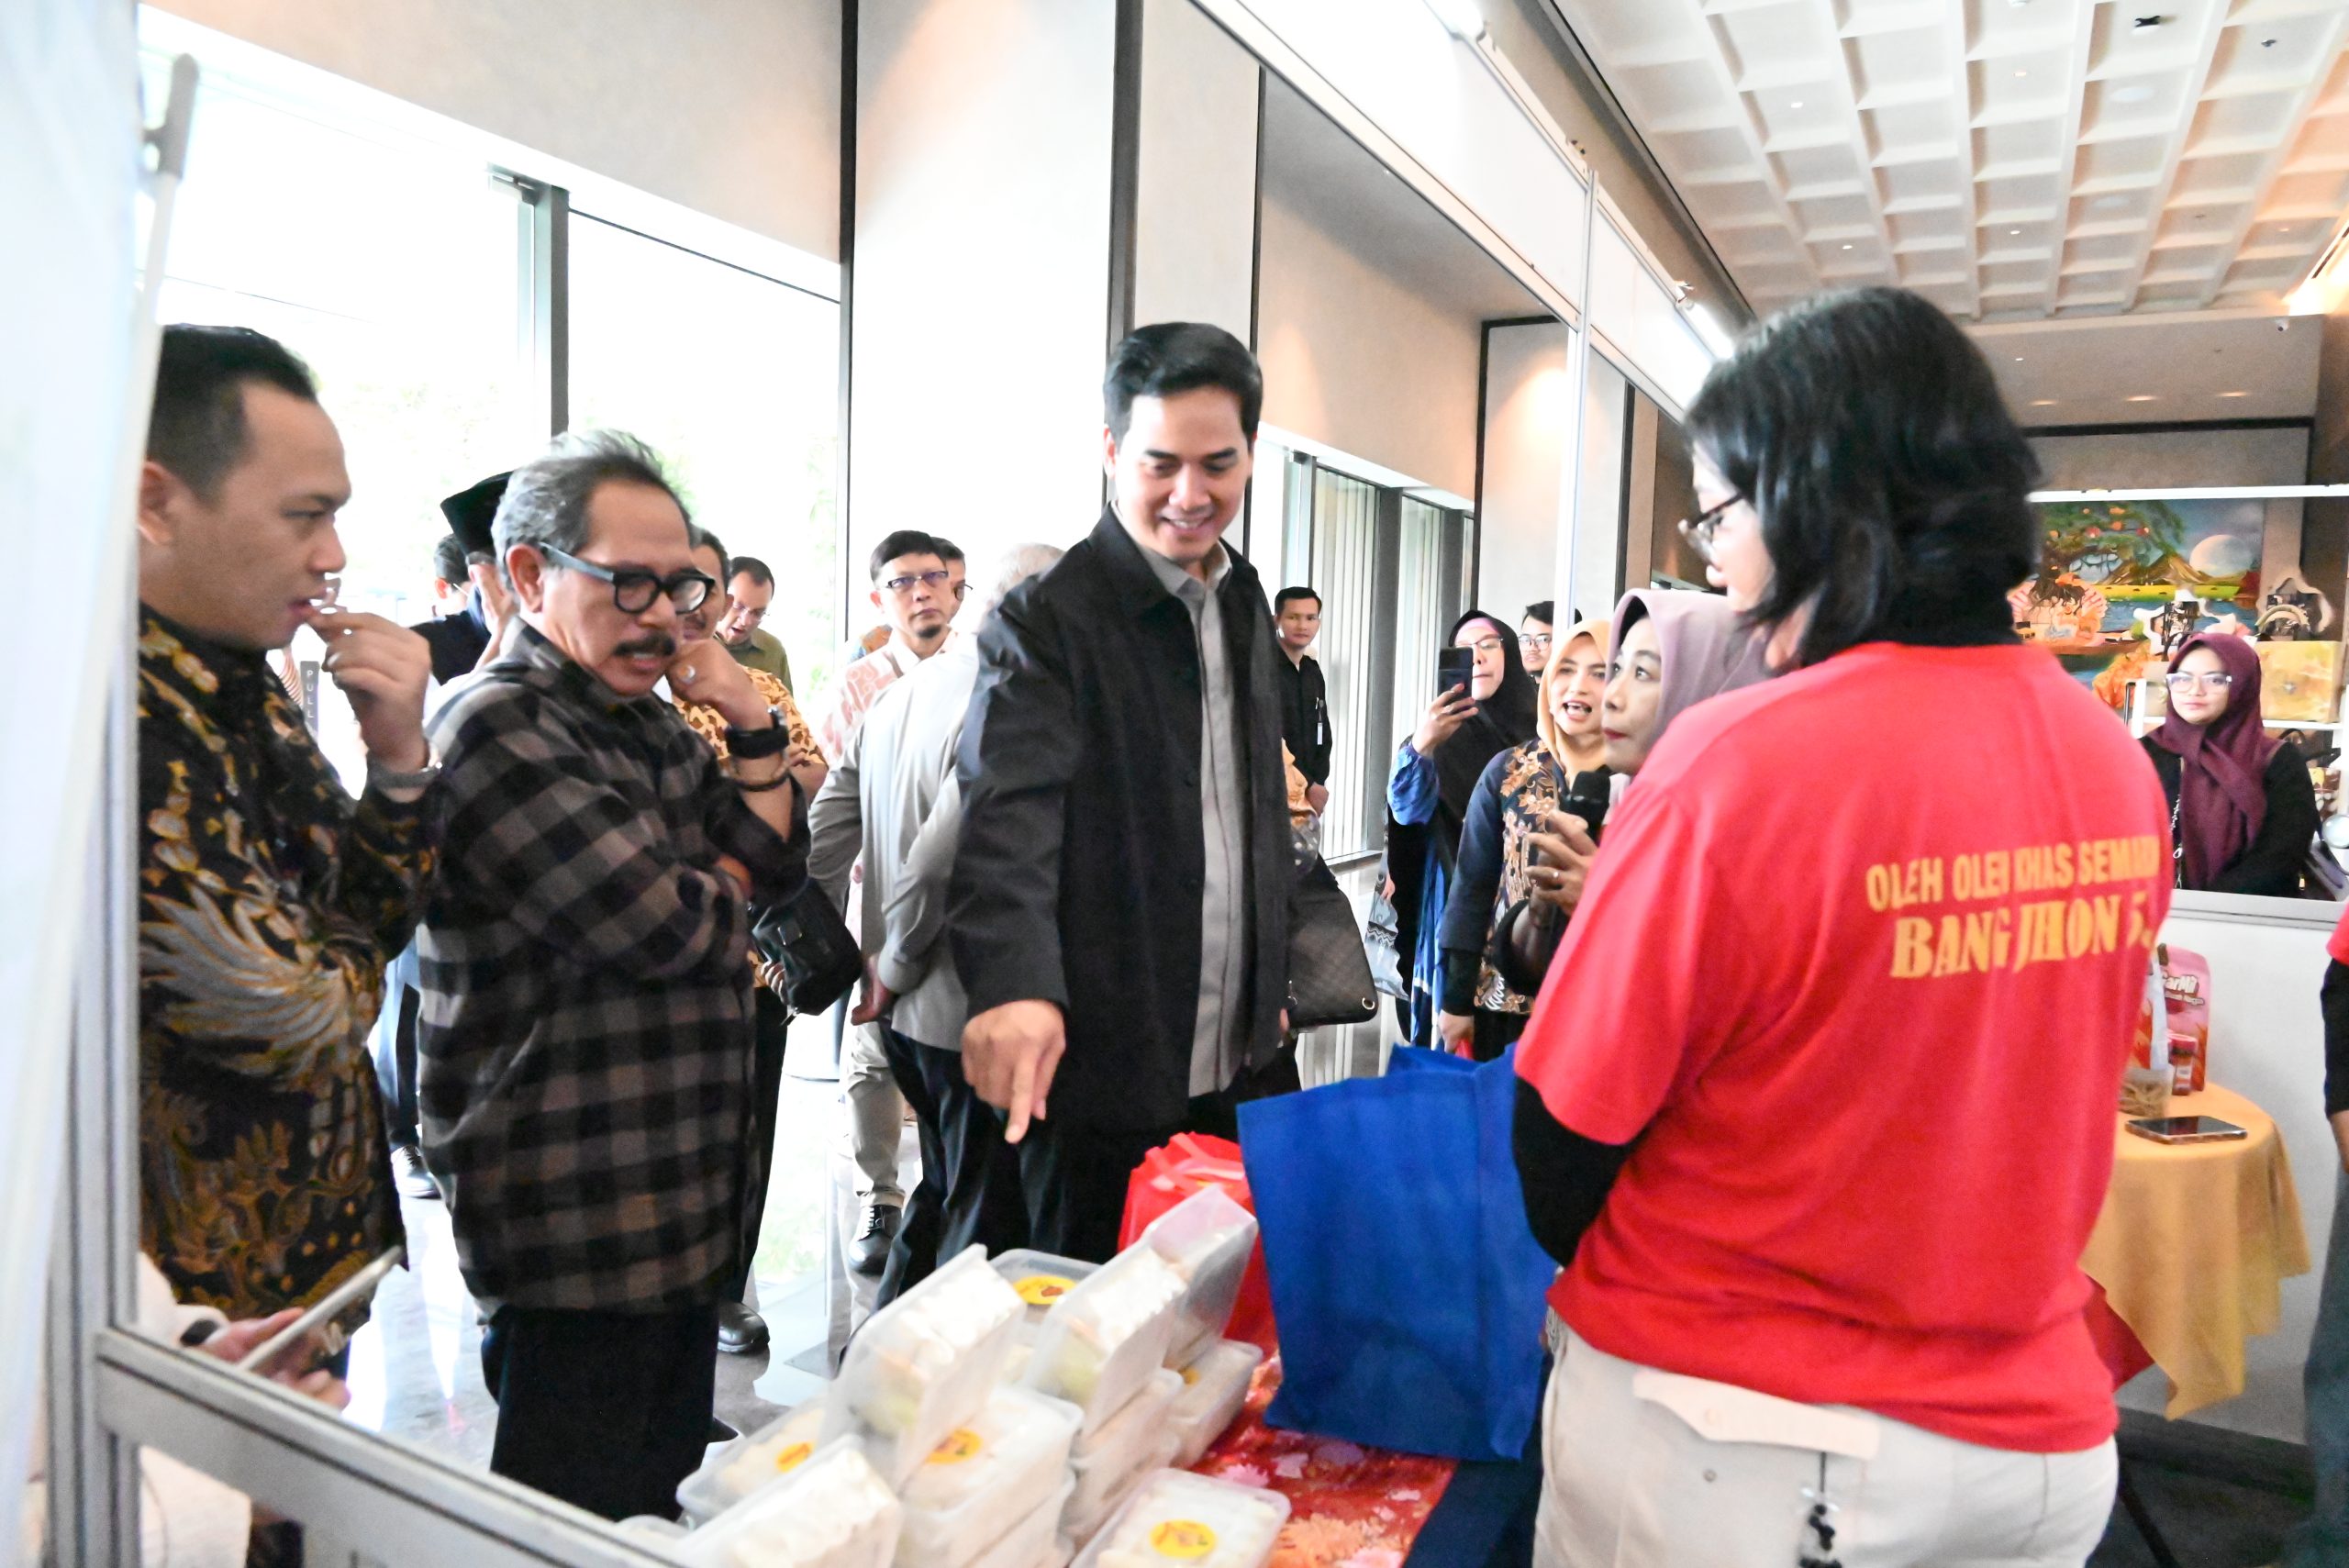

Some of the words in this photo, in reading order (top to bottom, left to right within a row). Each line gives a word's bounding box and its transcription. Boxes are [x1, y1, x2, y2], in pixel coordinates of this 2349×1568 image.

[306, 669, 316, 718] PULL
[1866, 856, 1943, 912] OLEH
[1890, 906, 2011, 978] BANG
[2013, 894, 2121, 973] JHON
